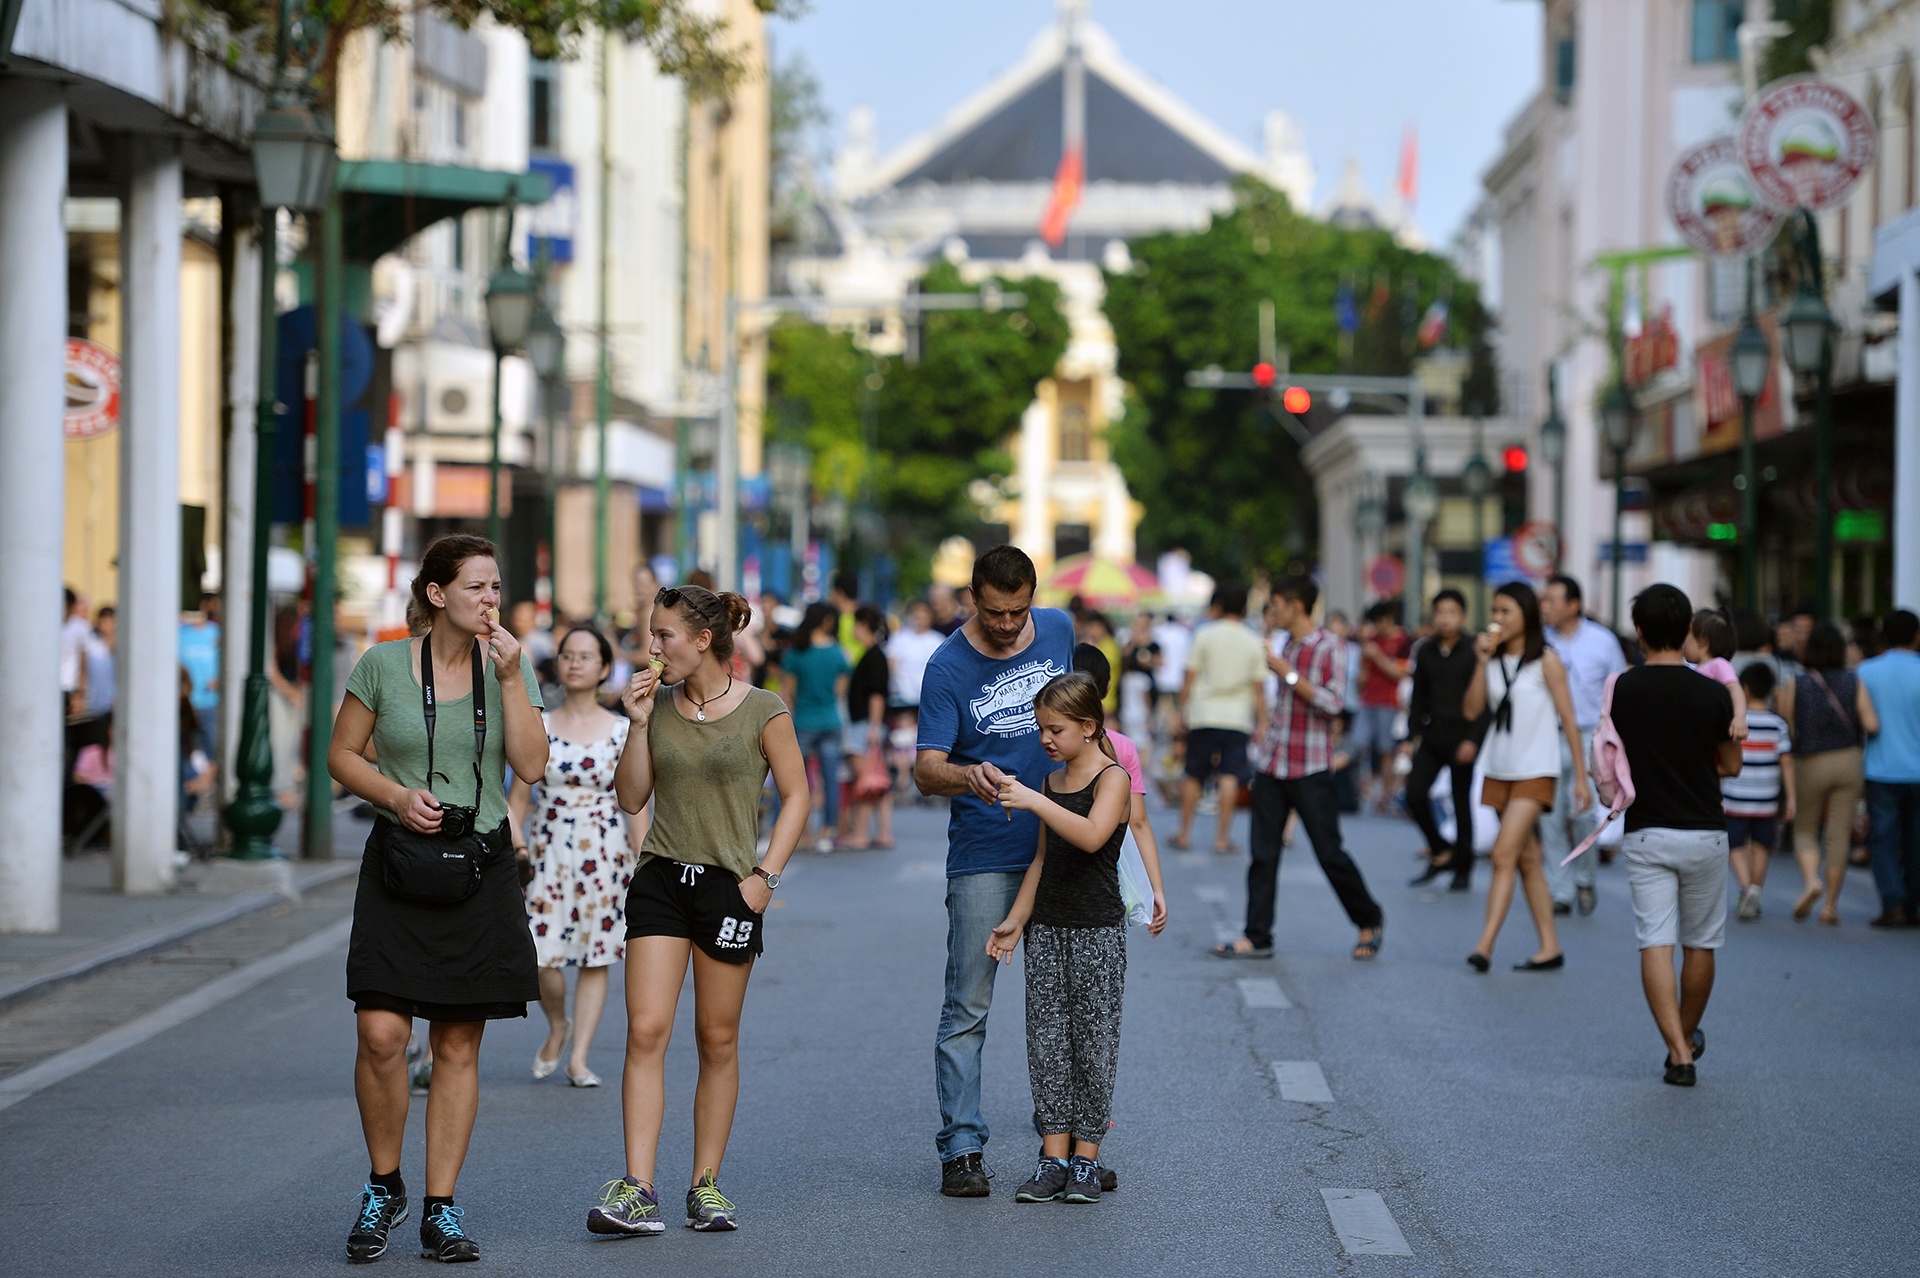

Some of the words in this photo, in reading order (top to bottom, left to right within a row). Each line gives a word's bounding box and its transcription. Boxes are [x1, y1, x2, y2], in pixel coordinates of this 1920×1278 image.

[998, 683, 1017, 698] MARC
[993, 698, 1004, 708] 19
[989, 708, 1017, 722] QUALITY
[1017, 706, 1023, 714] &
[1010, 729, 1026, 738] LEGACY
[719, 916, 754, 942] 89
